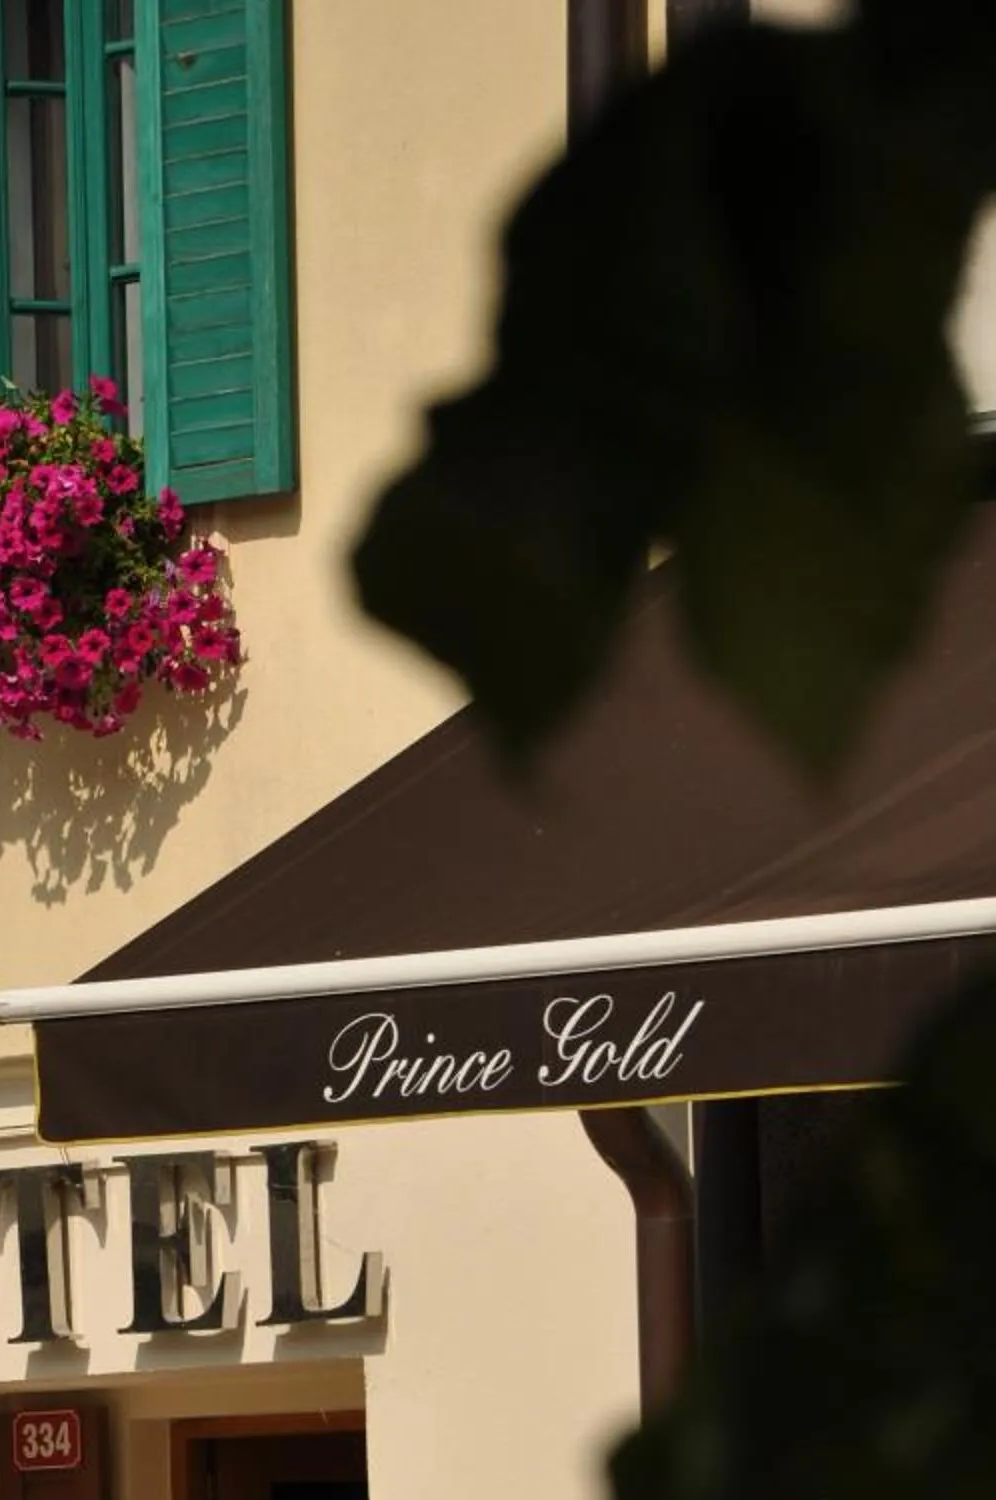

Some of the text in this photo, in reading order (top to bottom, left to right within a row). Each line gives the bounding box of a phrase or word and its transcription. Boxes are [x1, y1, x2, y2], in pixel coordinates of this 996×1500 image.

[323, 991, 705, 1103] Prince Gold
[22, 1420, 72, 1459] 334
